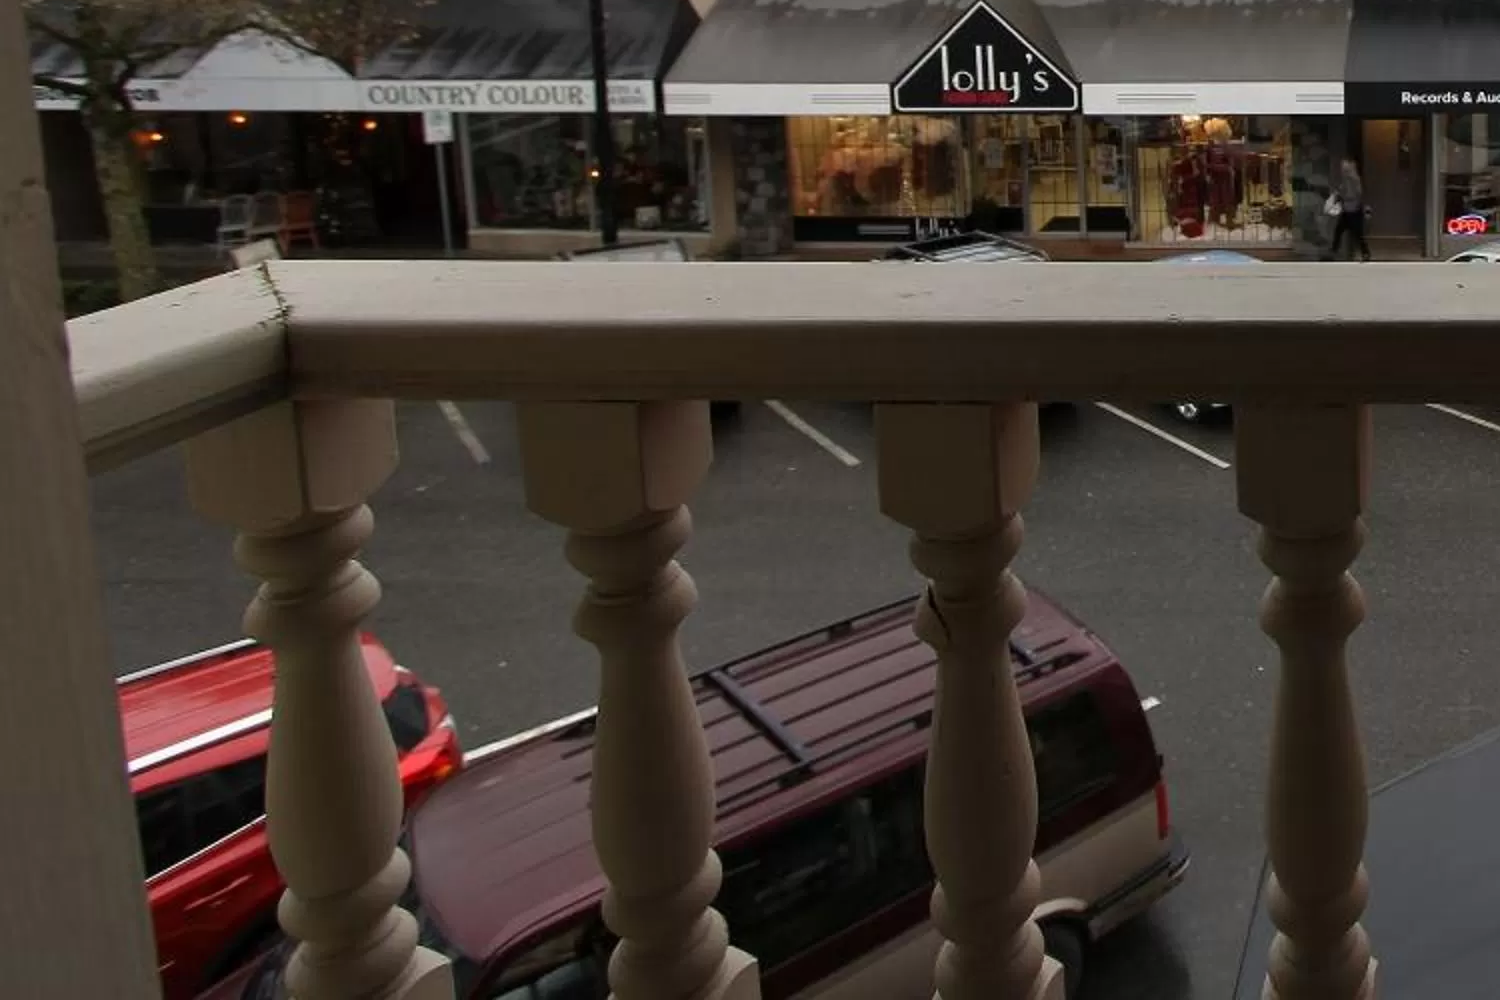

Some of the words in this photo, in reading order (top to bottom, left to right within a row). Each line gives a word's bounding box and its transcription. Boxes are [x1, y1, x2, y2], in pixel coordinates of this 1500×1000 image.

[941, 45, 1039, 103] lolly's
[368, 84, 480, 105] COUNTRY
[487, 84, 585, 105] COLOUR
[1401, 91, 1459, 105] Records
[1461, 91, 1473, 104] &
[1448, 219, 1486, 233] OPEN
